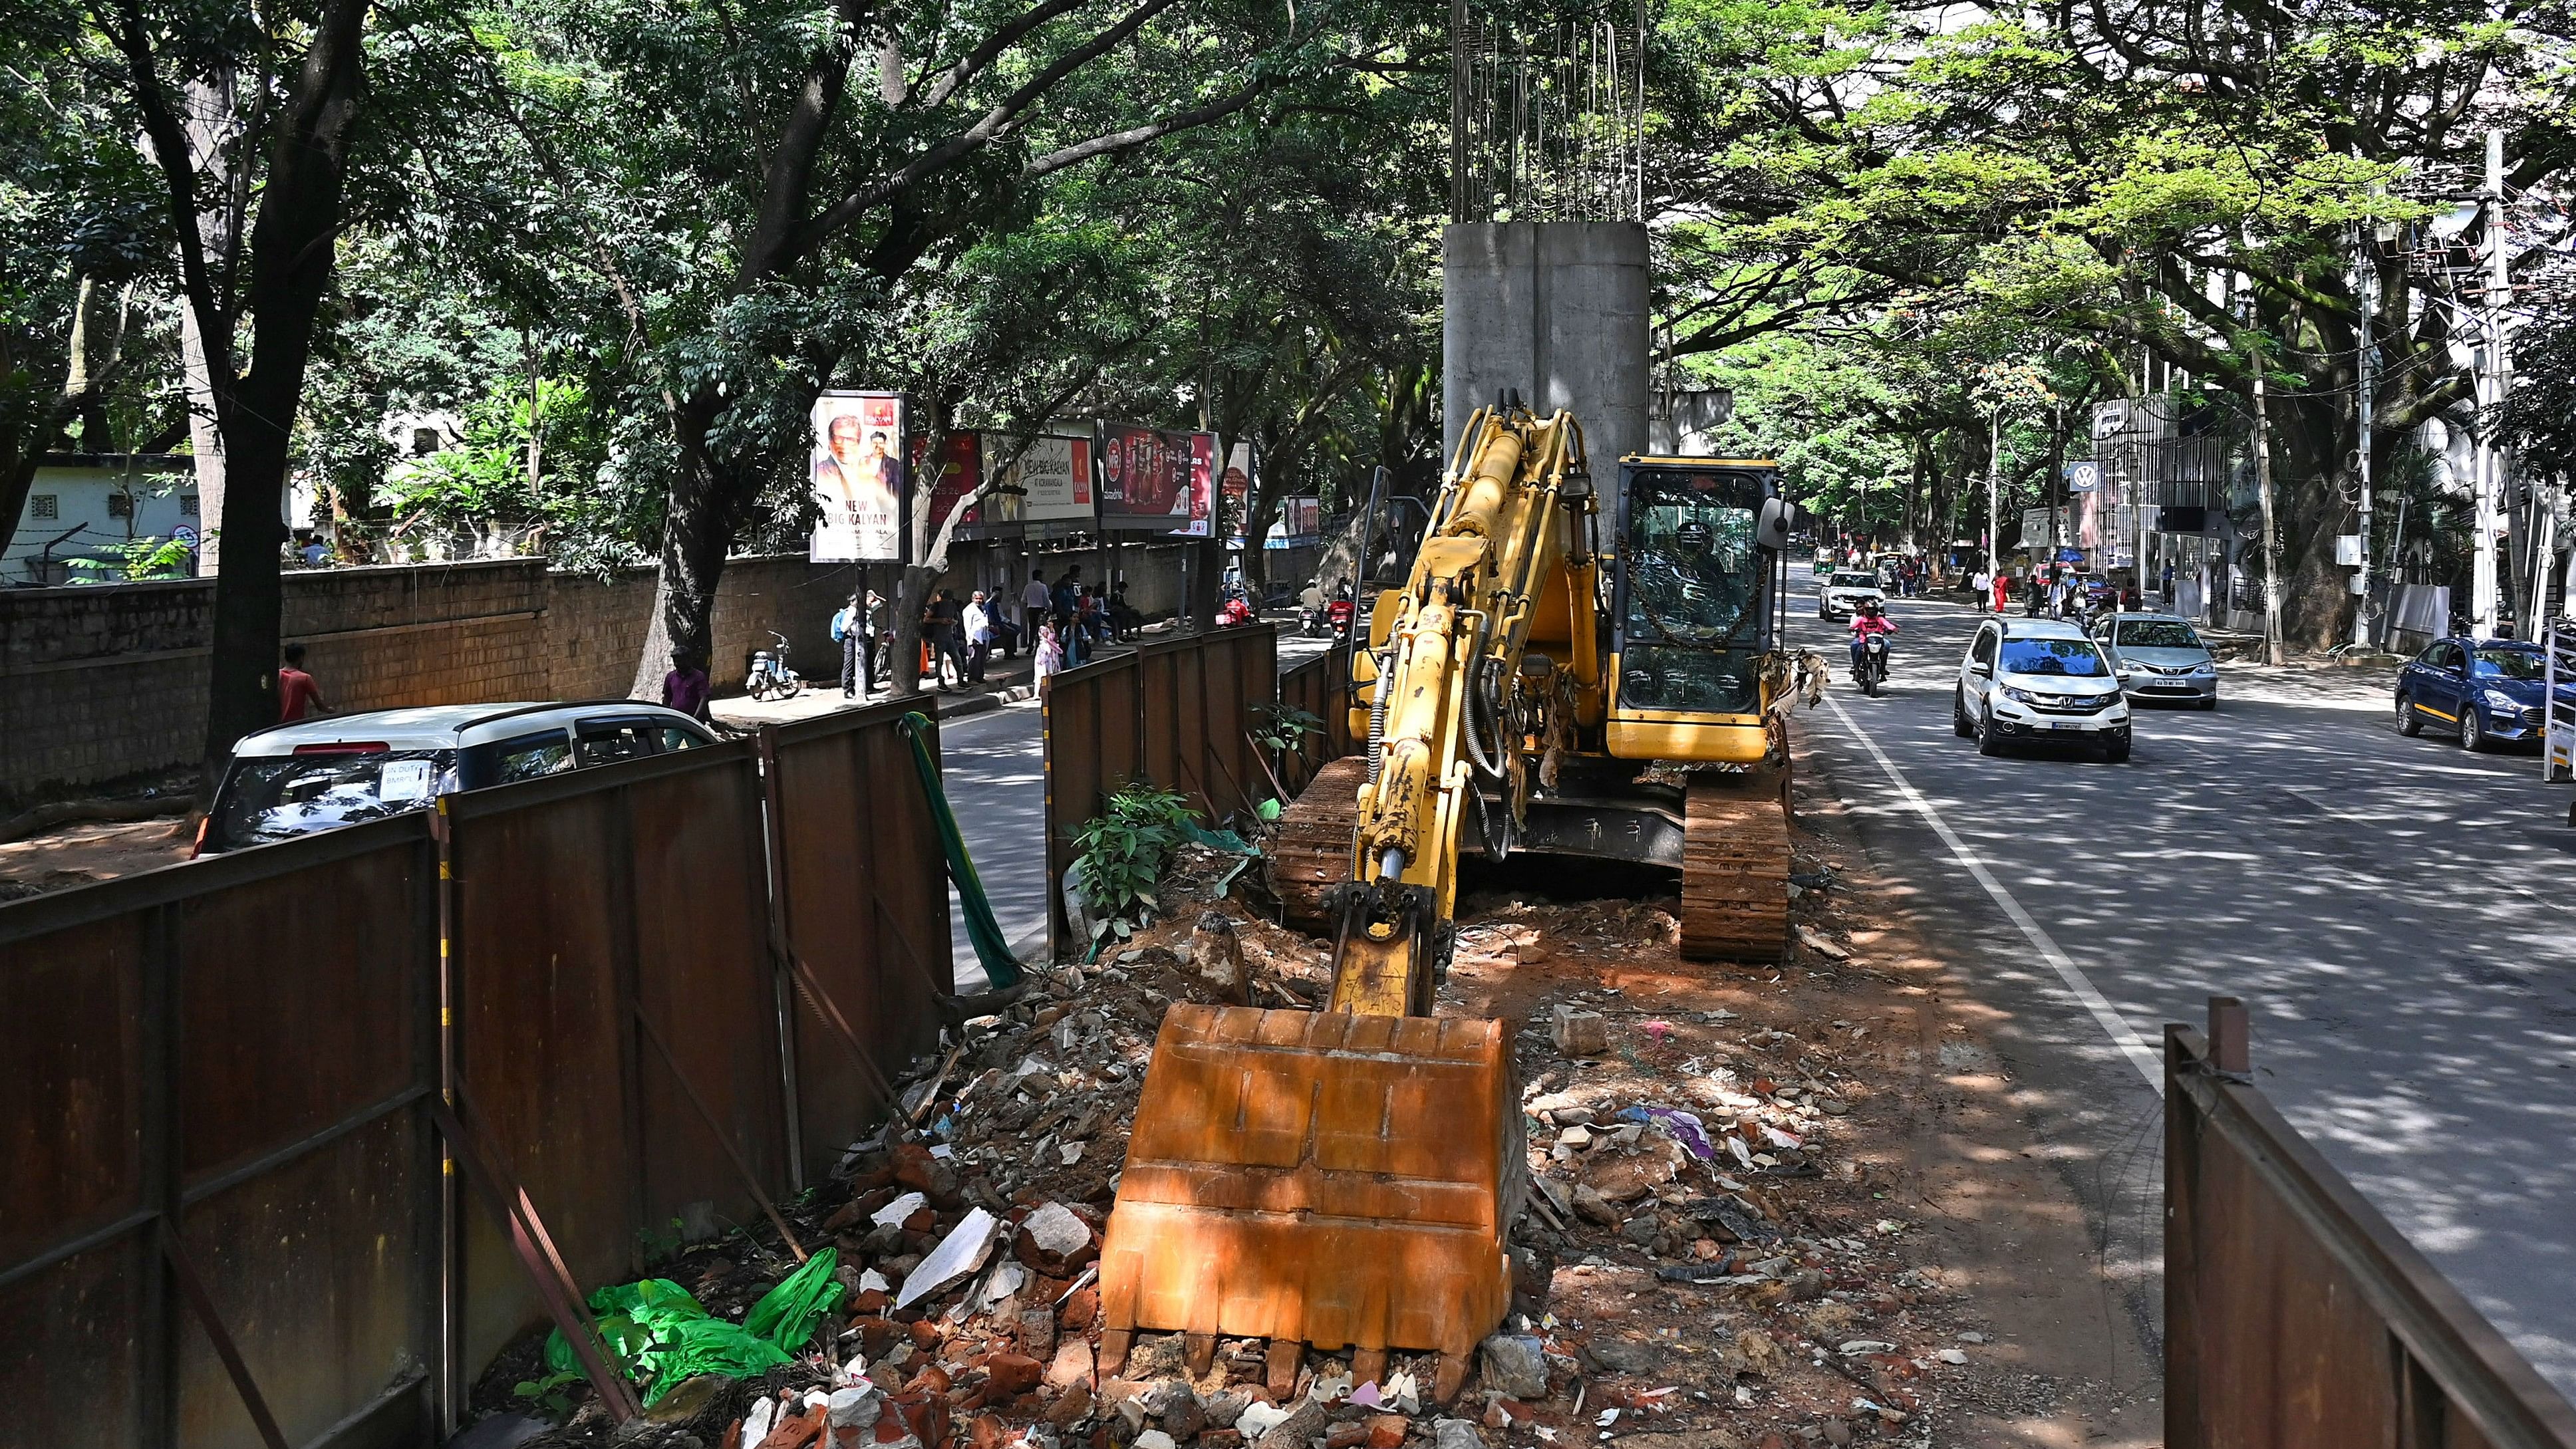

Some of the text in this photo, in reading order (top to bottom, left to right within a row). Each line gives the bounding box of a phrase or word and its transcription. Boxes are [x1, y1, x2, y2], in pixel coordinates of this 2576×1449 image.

[1050, 460, 1070, 475] KALYAN
[845, 500, 867, 512] NEW
[827, 513, 887, 525] BIG KALYAN
